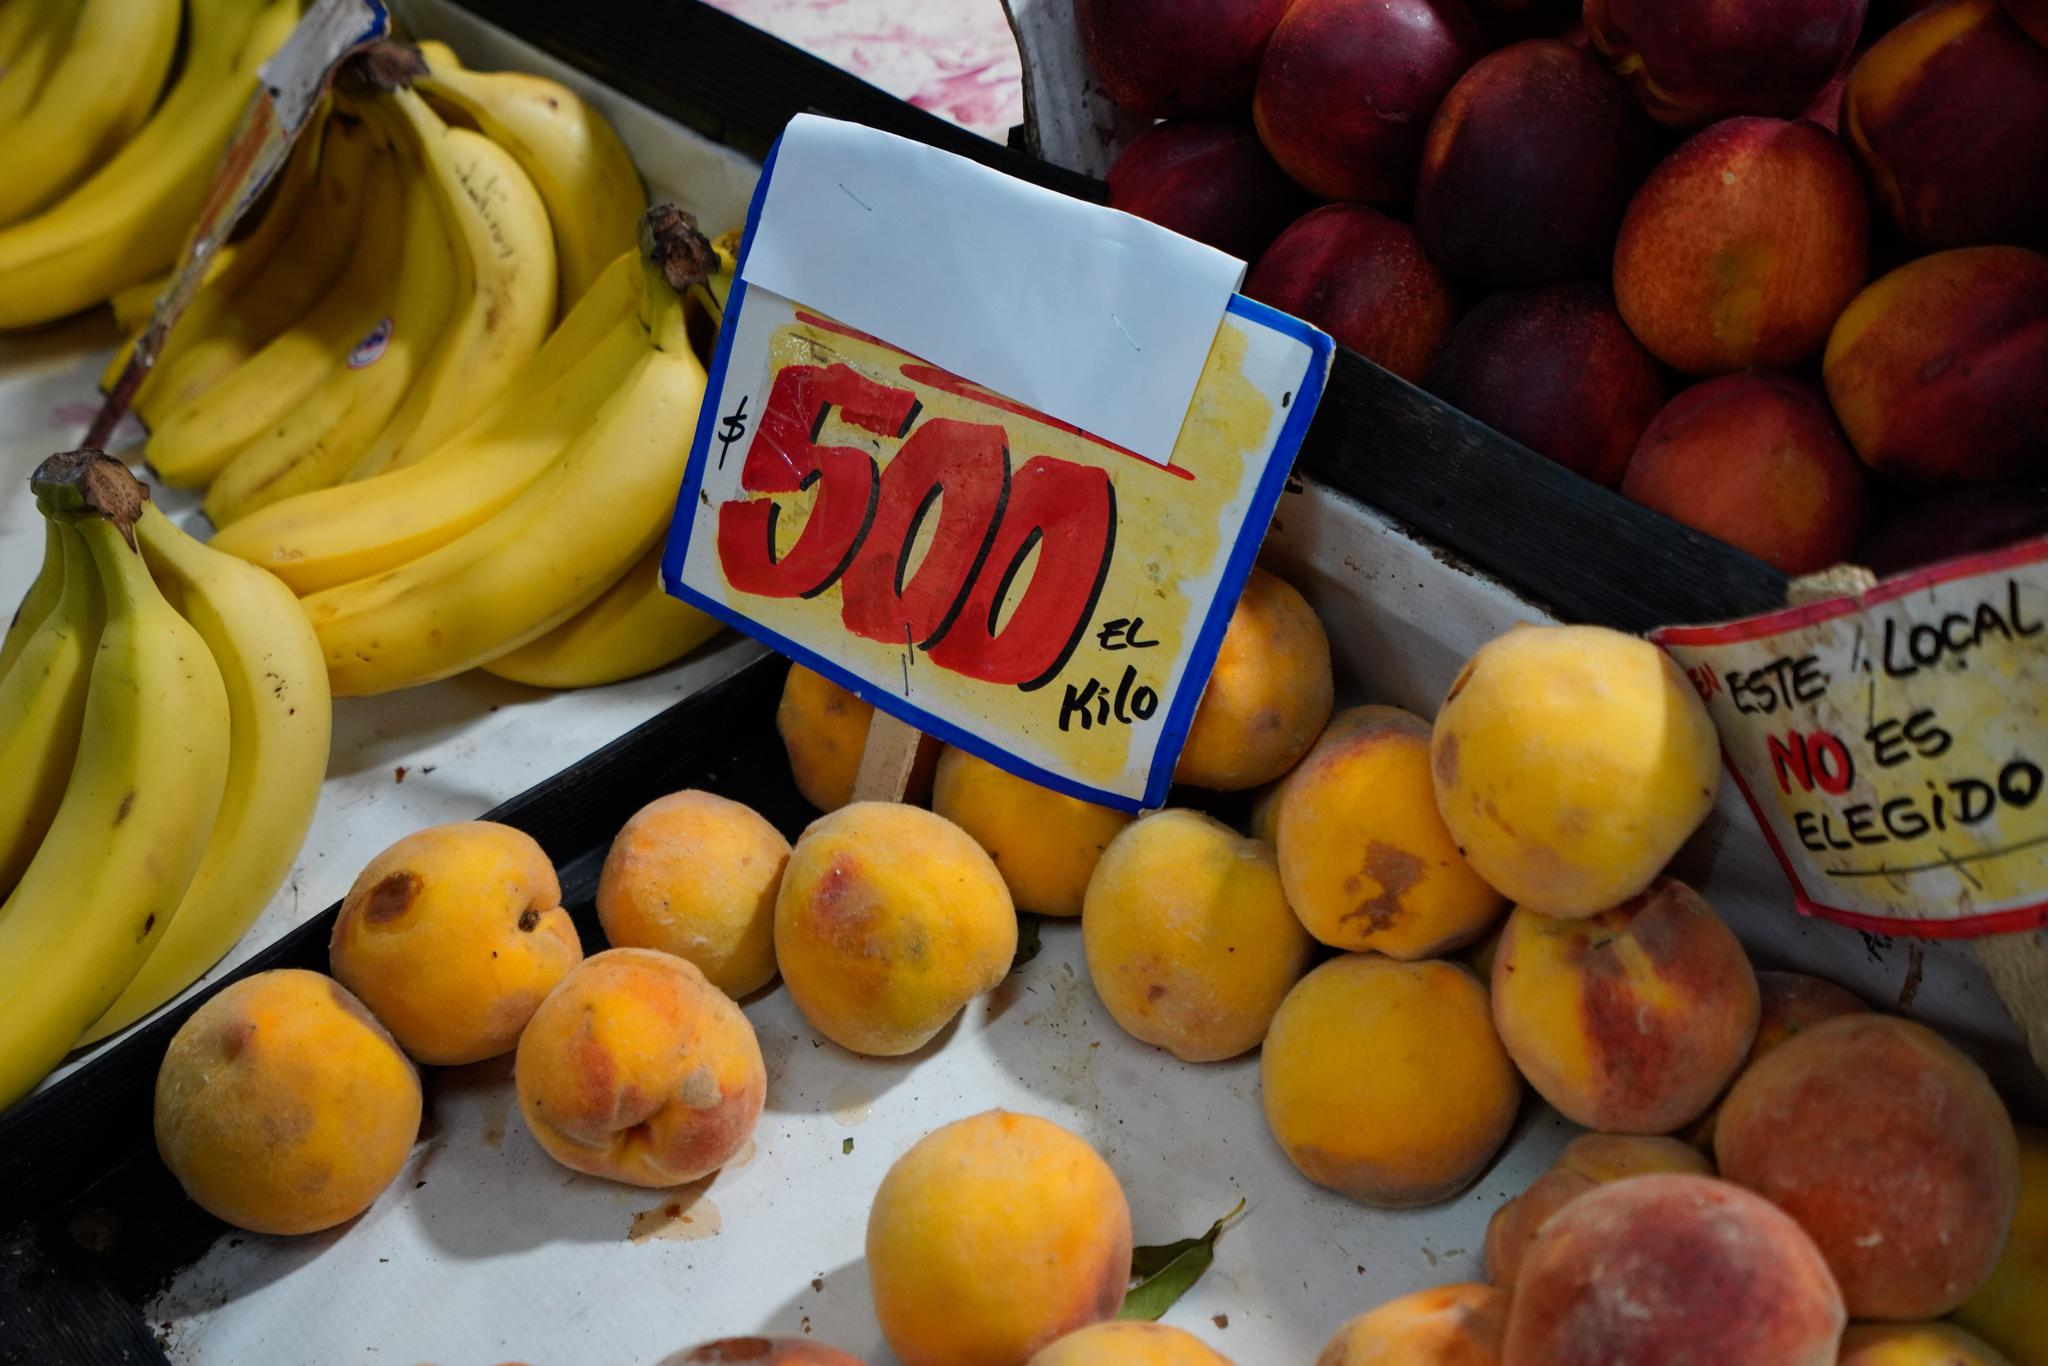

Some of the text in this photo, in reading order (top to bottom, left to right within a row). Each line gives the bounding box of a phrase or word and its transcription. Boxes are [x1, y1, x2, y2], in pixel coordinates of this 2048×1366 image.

[717, 362, 1118, 693] $ 500
[1097, 617, 1159, 651] EL
[1725, 654, 1827, 715] ESTE
[1882, 578, 2044, 679] LOCAL
[1766, 708, 1953, 797] NO ES
